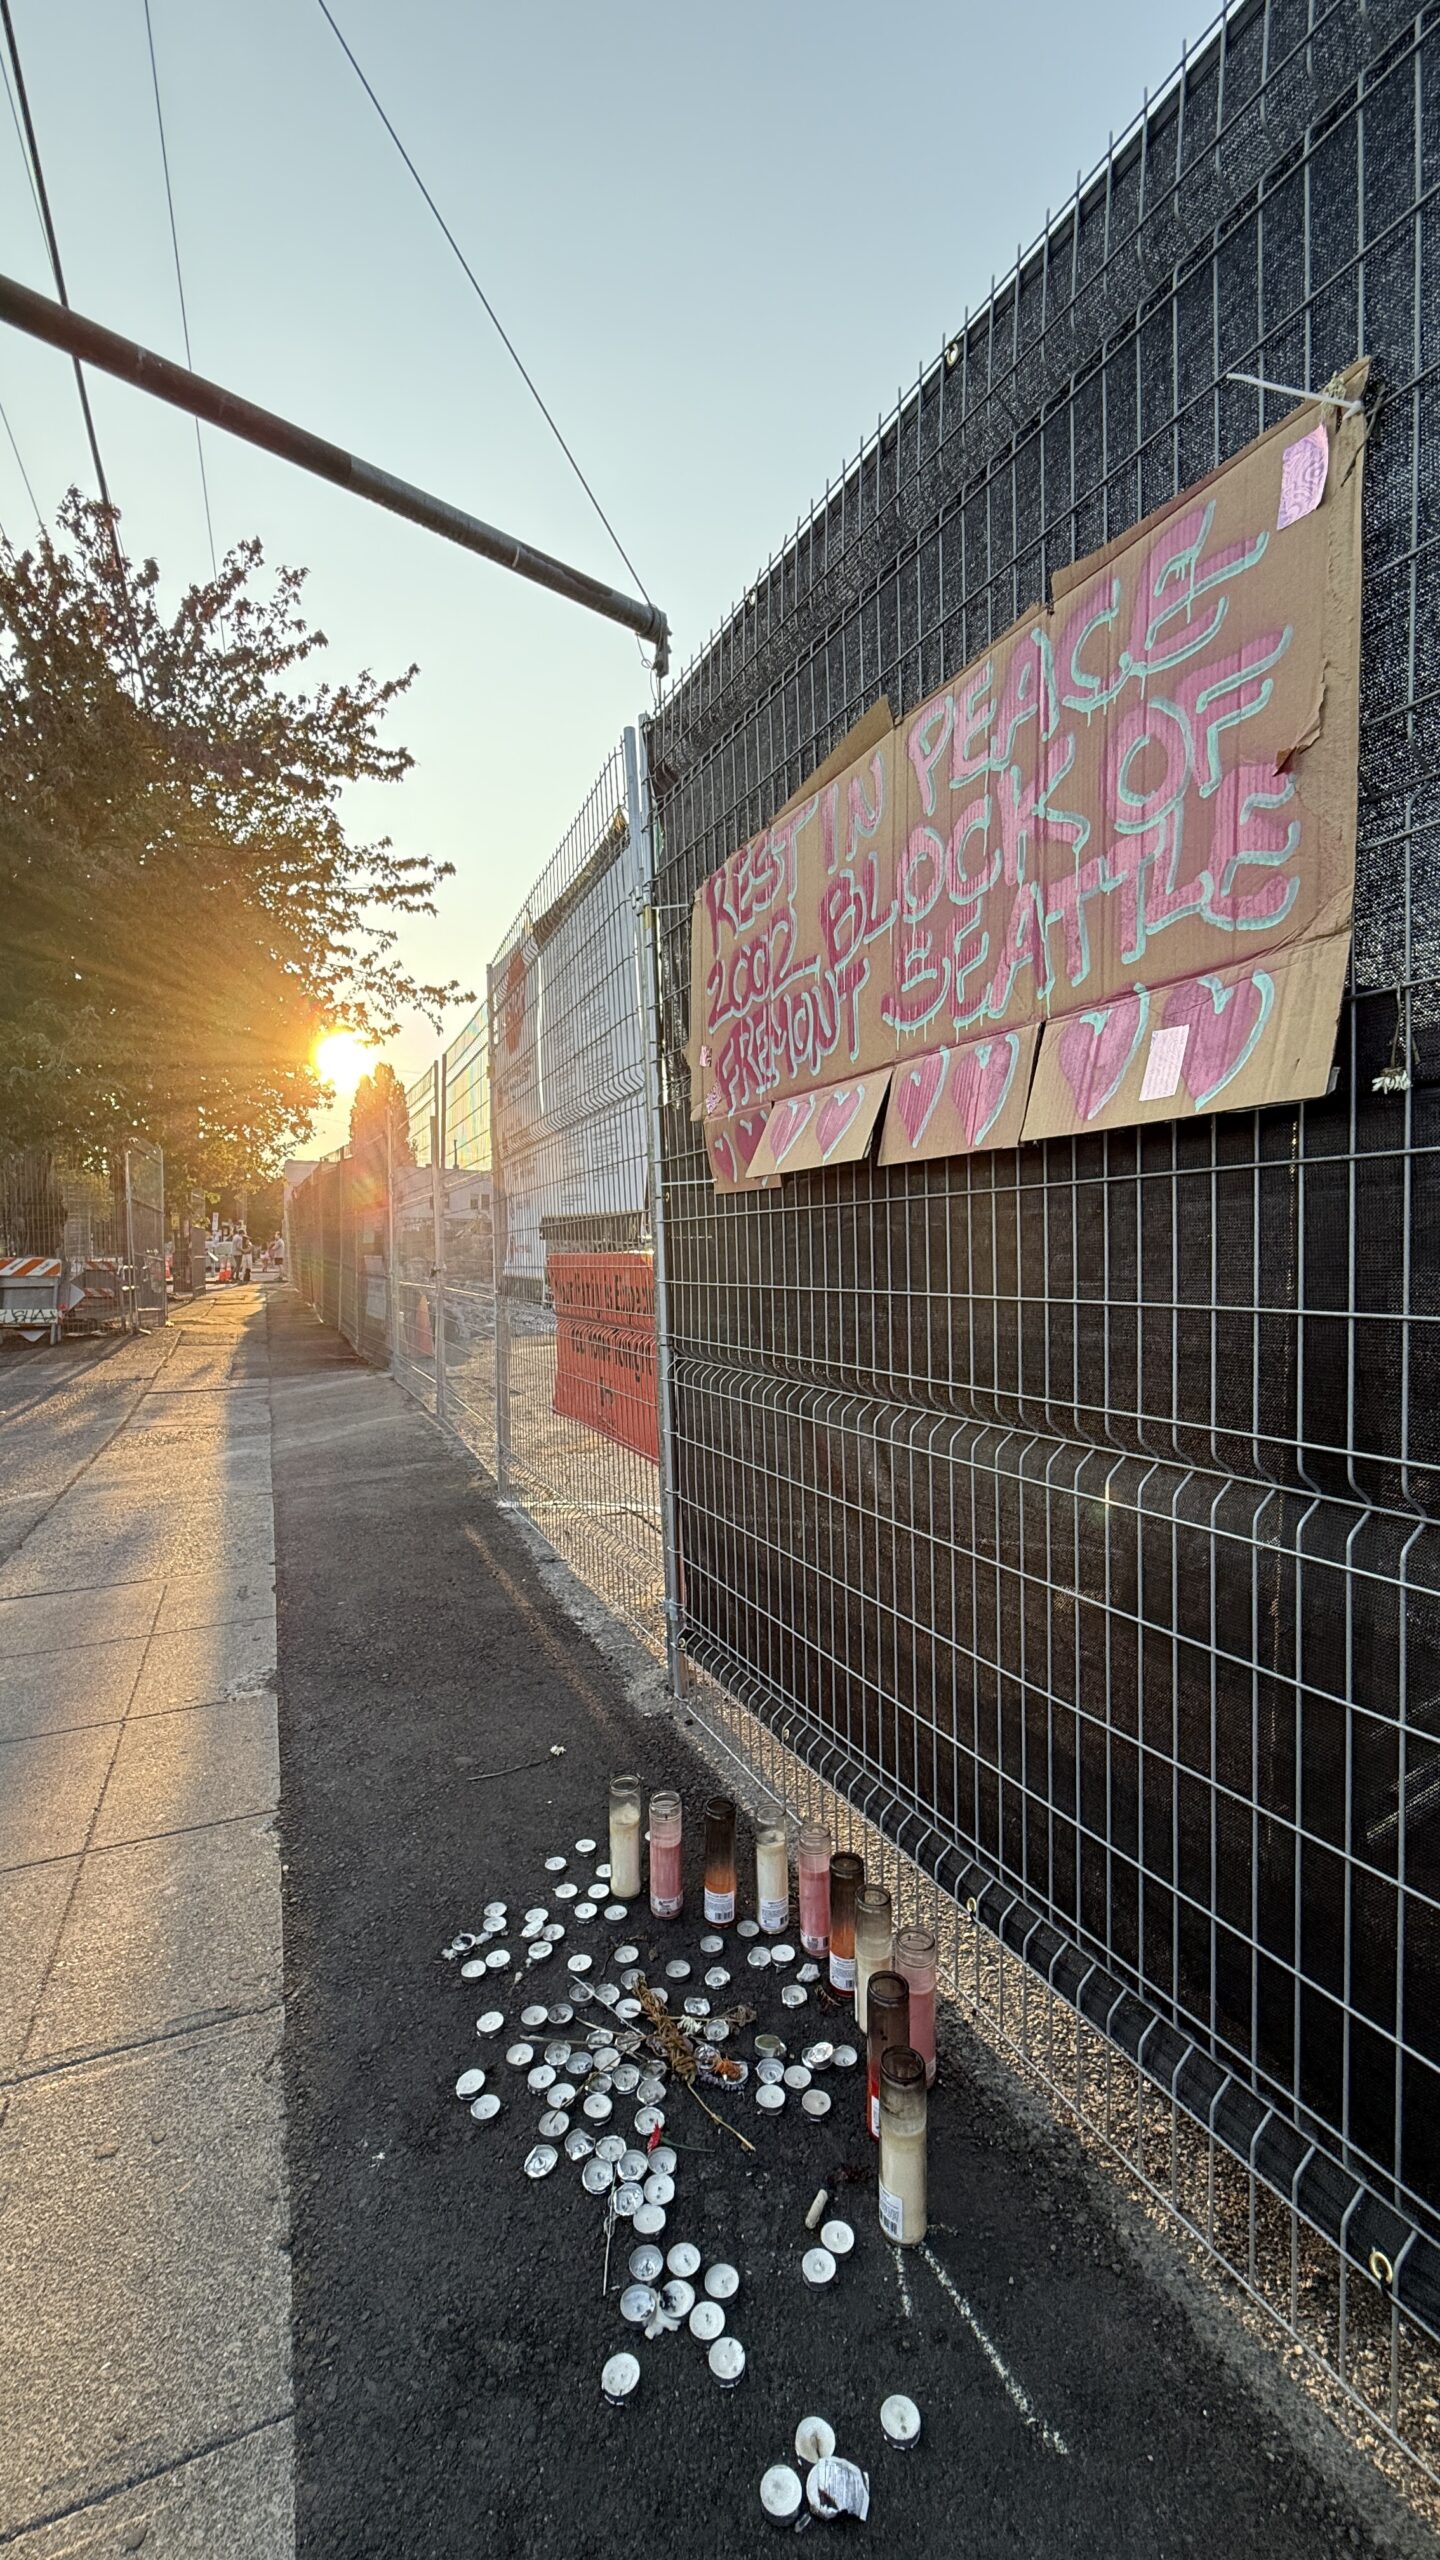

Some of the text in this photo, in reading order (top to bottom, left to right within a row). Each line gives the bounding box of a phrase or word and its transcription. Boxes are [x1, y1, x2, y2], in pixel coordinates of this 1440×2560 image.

[706, 499, 1271, 961] REST IN PEACE
[819, 731, 1091, 976] BLOCK
[1107, 624, 1294, 836] OF
[715, 958, 870, 1117] FREMONT
[880, 763, 1302, 1034] SEATTLE
